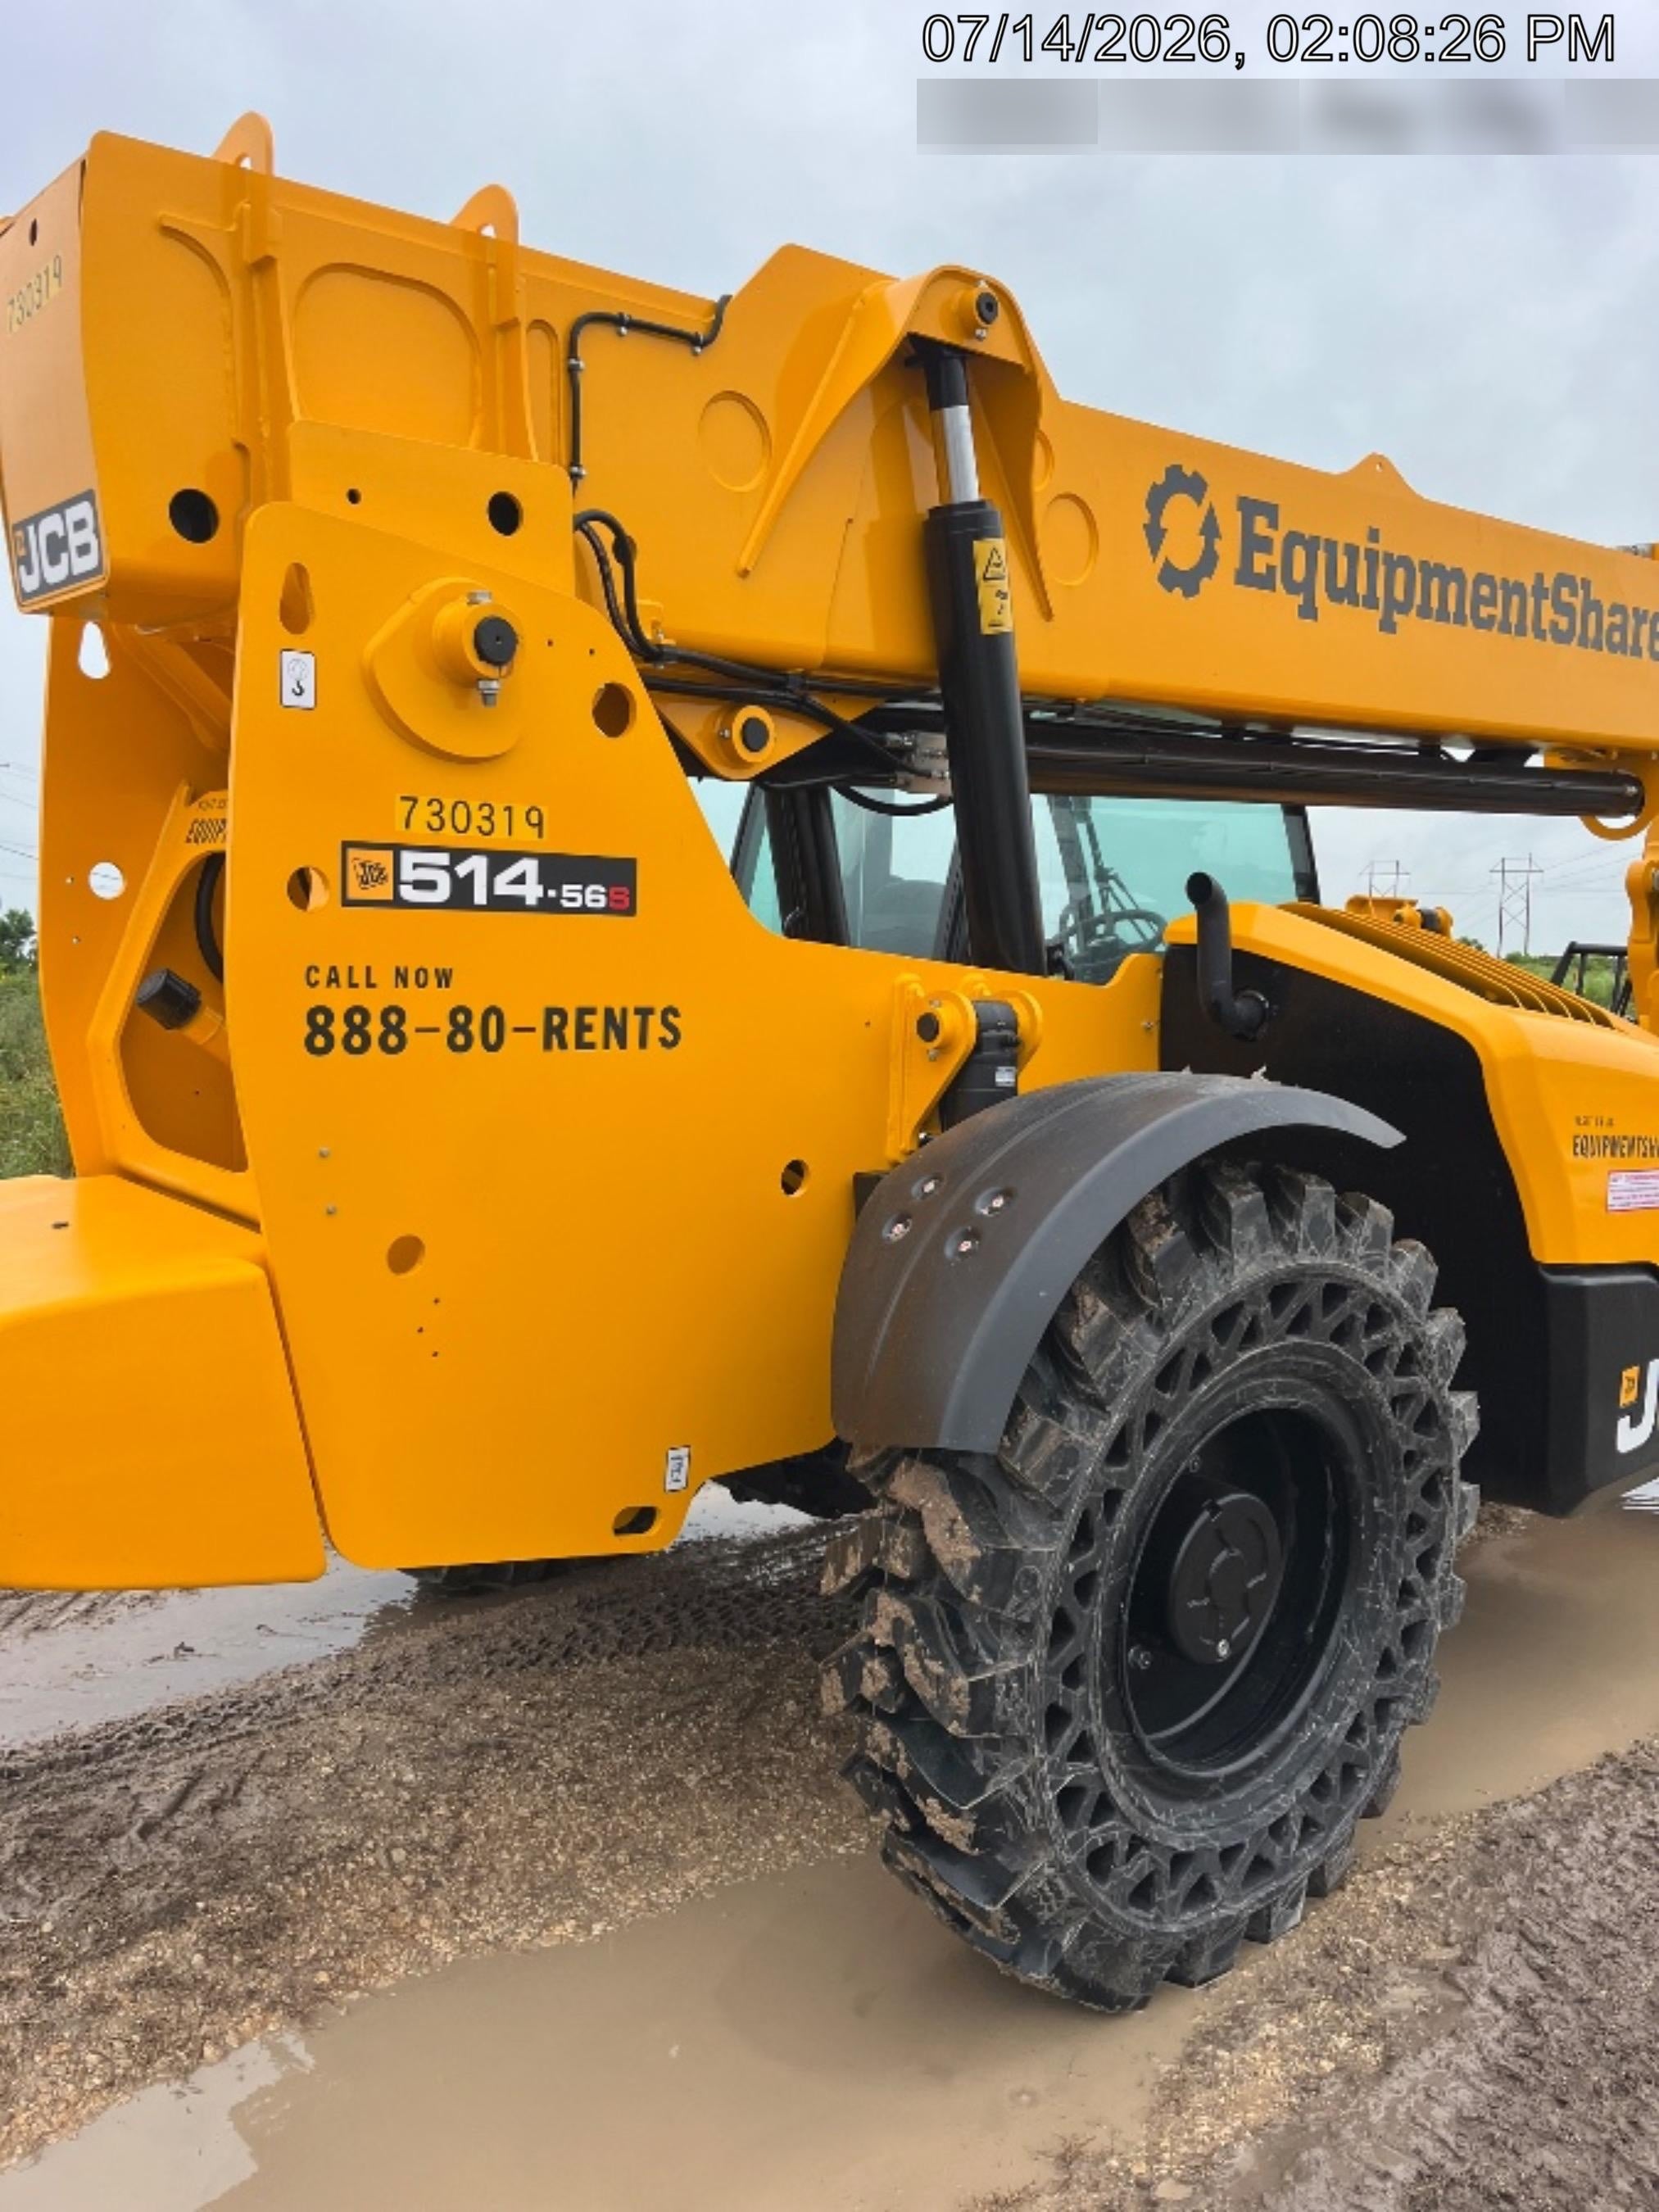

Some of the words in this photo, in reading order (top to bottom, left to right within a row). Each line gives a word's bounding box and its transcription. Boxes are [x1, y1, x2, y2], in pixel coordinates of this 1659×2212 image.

[8, 255, 62, 333] 730319
[19, 501, 99, 593] JCB
[186, 818, 227, 844] EQUIP
[400, 796, 544, 839] 730319
[305, 964, 378, 989] CALL
[394, 966, 453, 989] NOW
[304, 1004, 682, 1055] 888-80-RENTS
